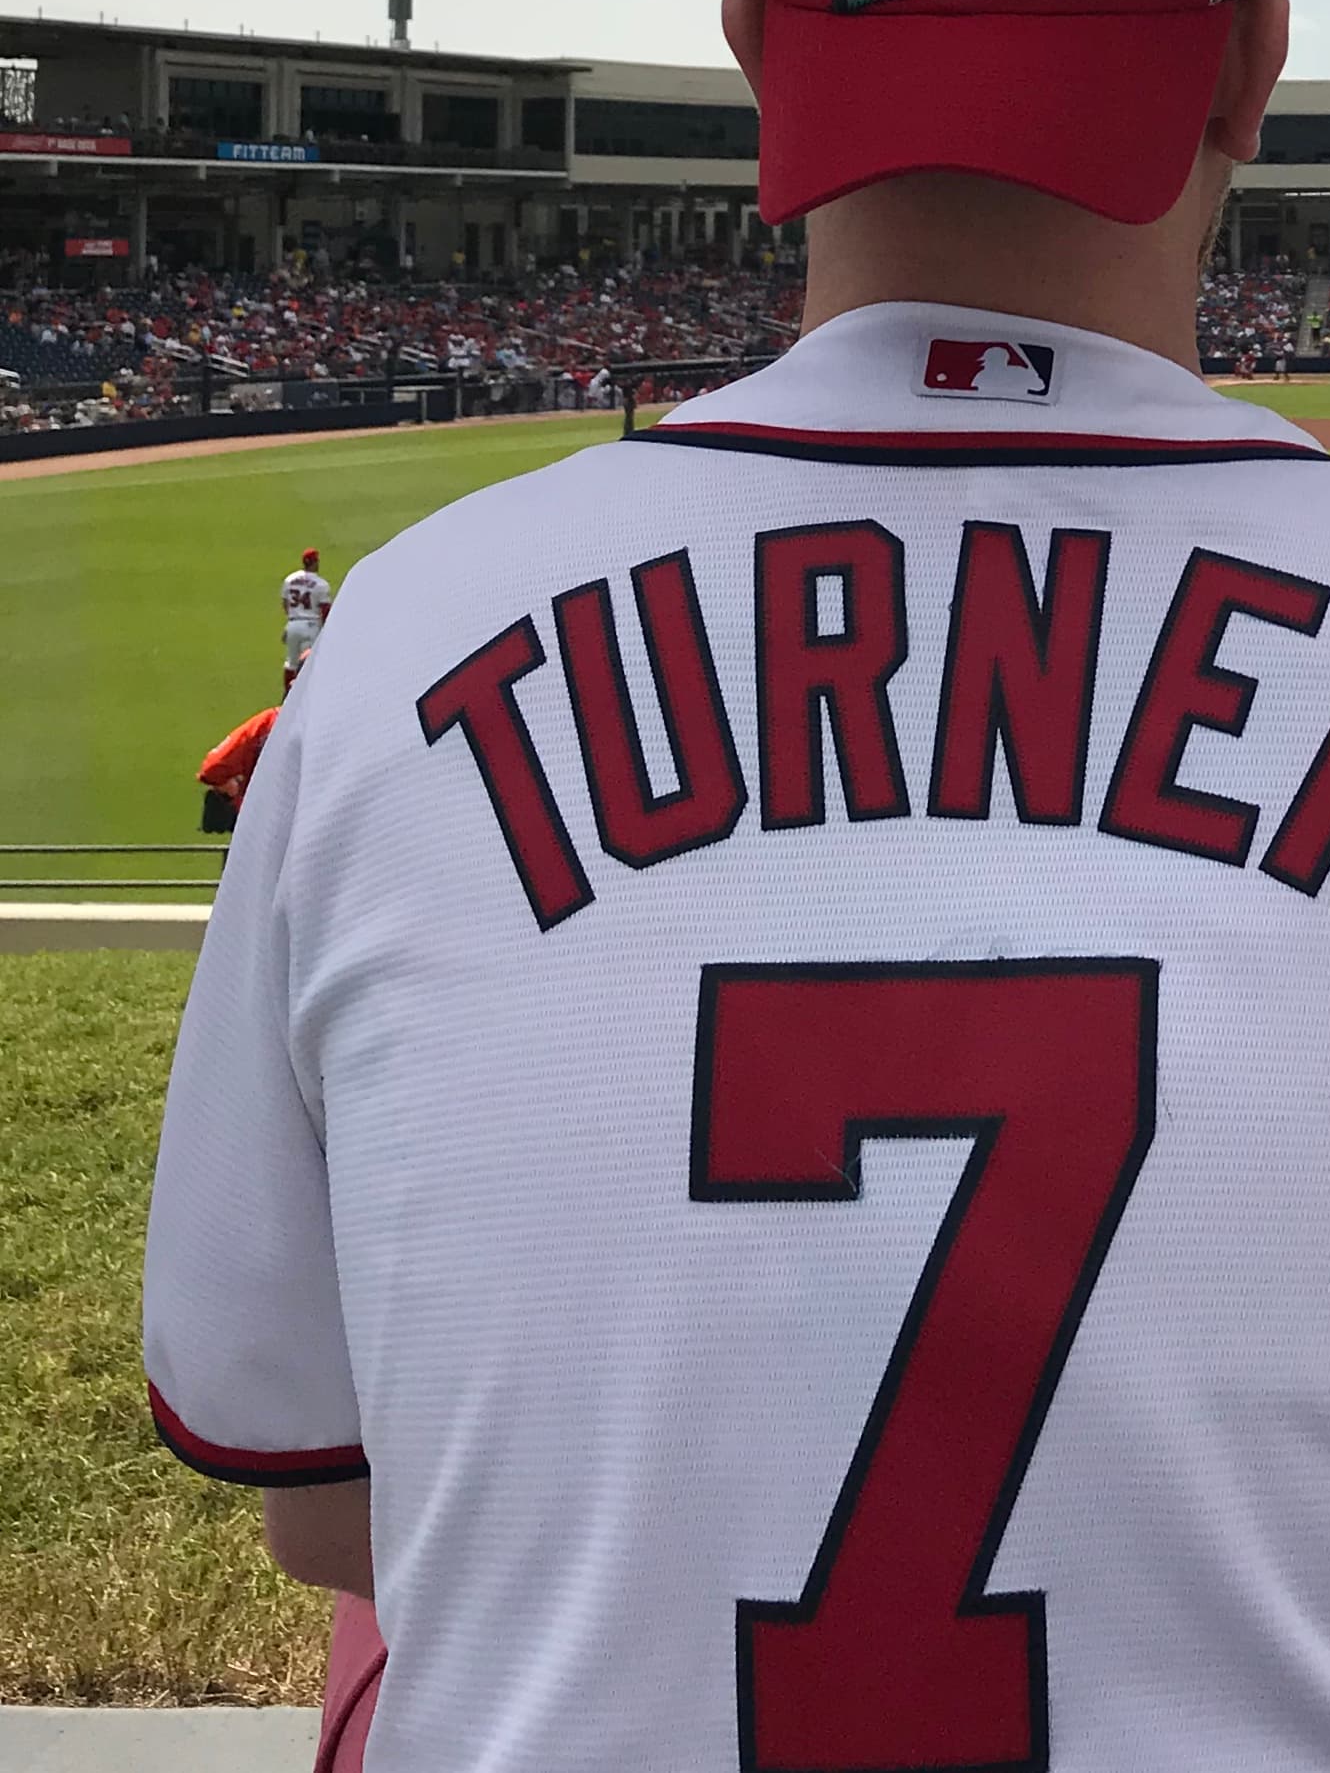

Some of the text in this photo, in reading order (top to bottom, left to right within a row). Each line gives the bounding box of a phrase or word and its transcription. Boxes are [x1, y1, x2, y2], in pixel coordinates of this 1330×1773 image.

[233, 144, 305, 161] FITTEAM
[289, 588, 312, 610] 34
[689, 957, 1161, 1773] 7
